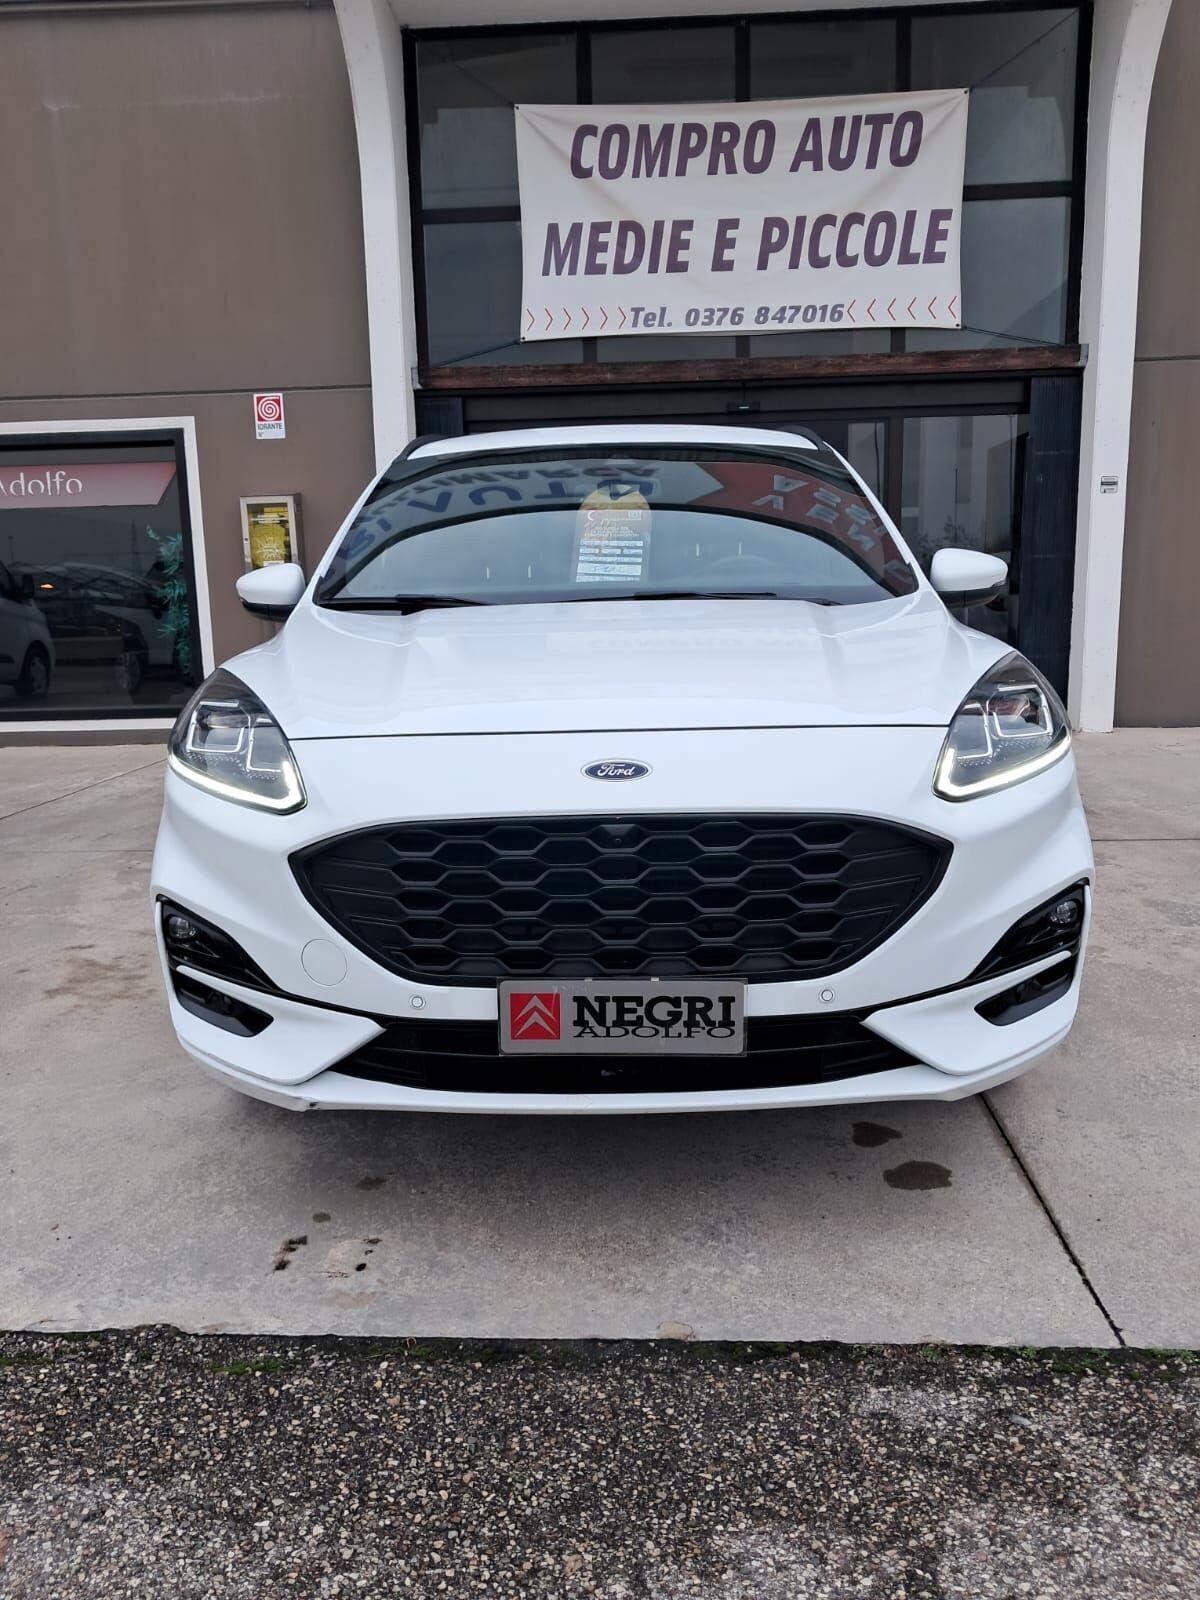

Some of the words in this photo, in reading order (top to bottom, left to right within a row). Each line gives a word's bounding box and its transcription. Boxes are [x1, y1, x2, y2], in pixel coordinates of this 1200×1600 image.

[570, 119, 776, 180] COMPRO
[789, 110, 924, 172] AUTO
[542, 220, 694, 276] MEDIE
[711, 217, 740, 272] E
[756, 208, 953, 271] PICCOLE
[630, 305, 673, 328] Tel.
[685, 306, 744, 326] 0376
[754, 303, 844, 325] 847016
[597, 763, 635, 776] Ford
[572, 995, 736, 1027] NEGRI
[572, 1025, 736, 1038] ADOLFO
